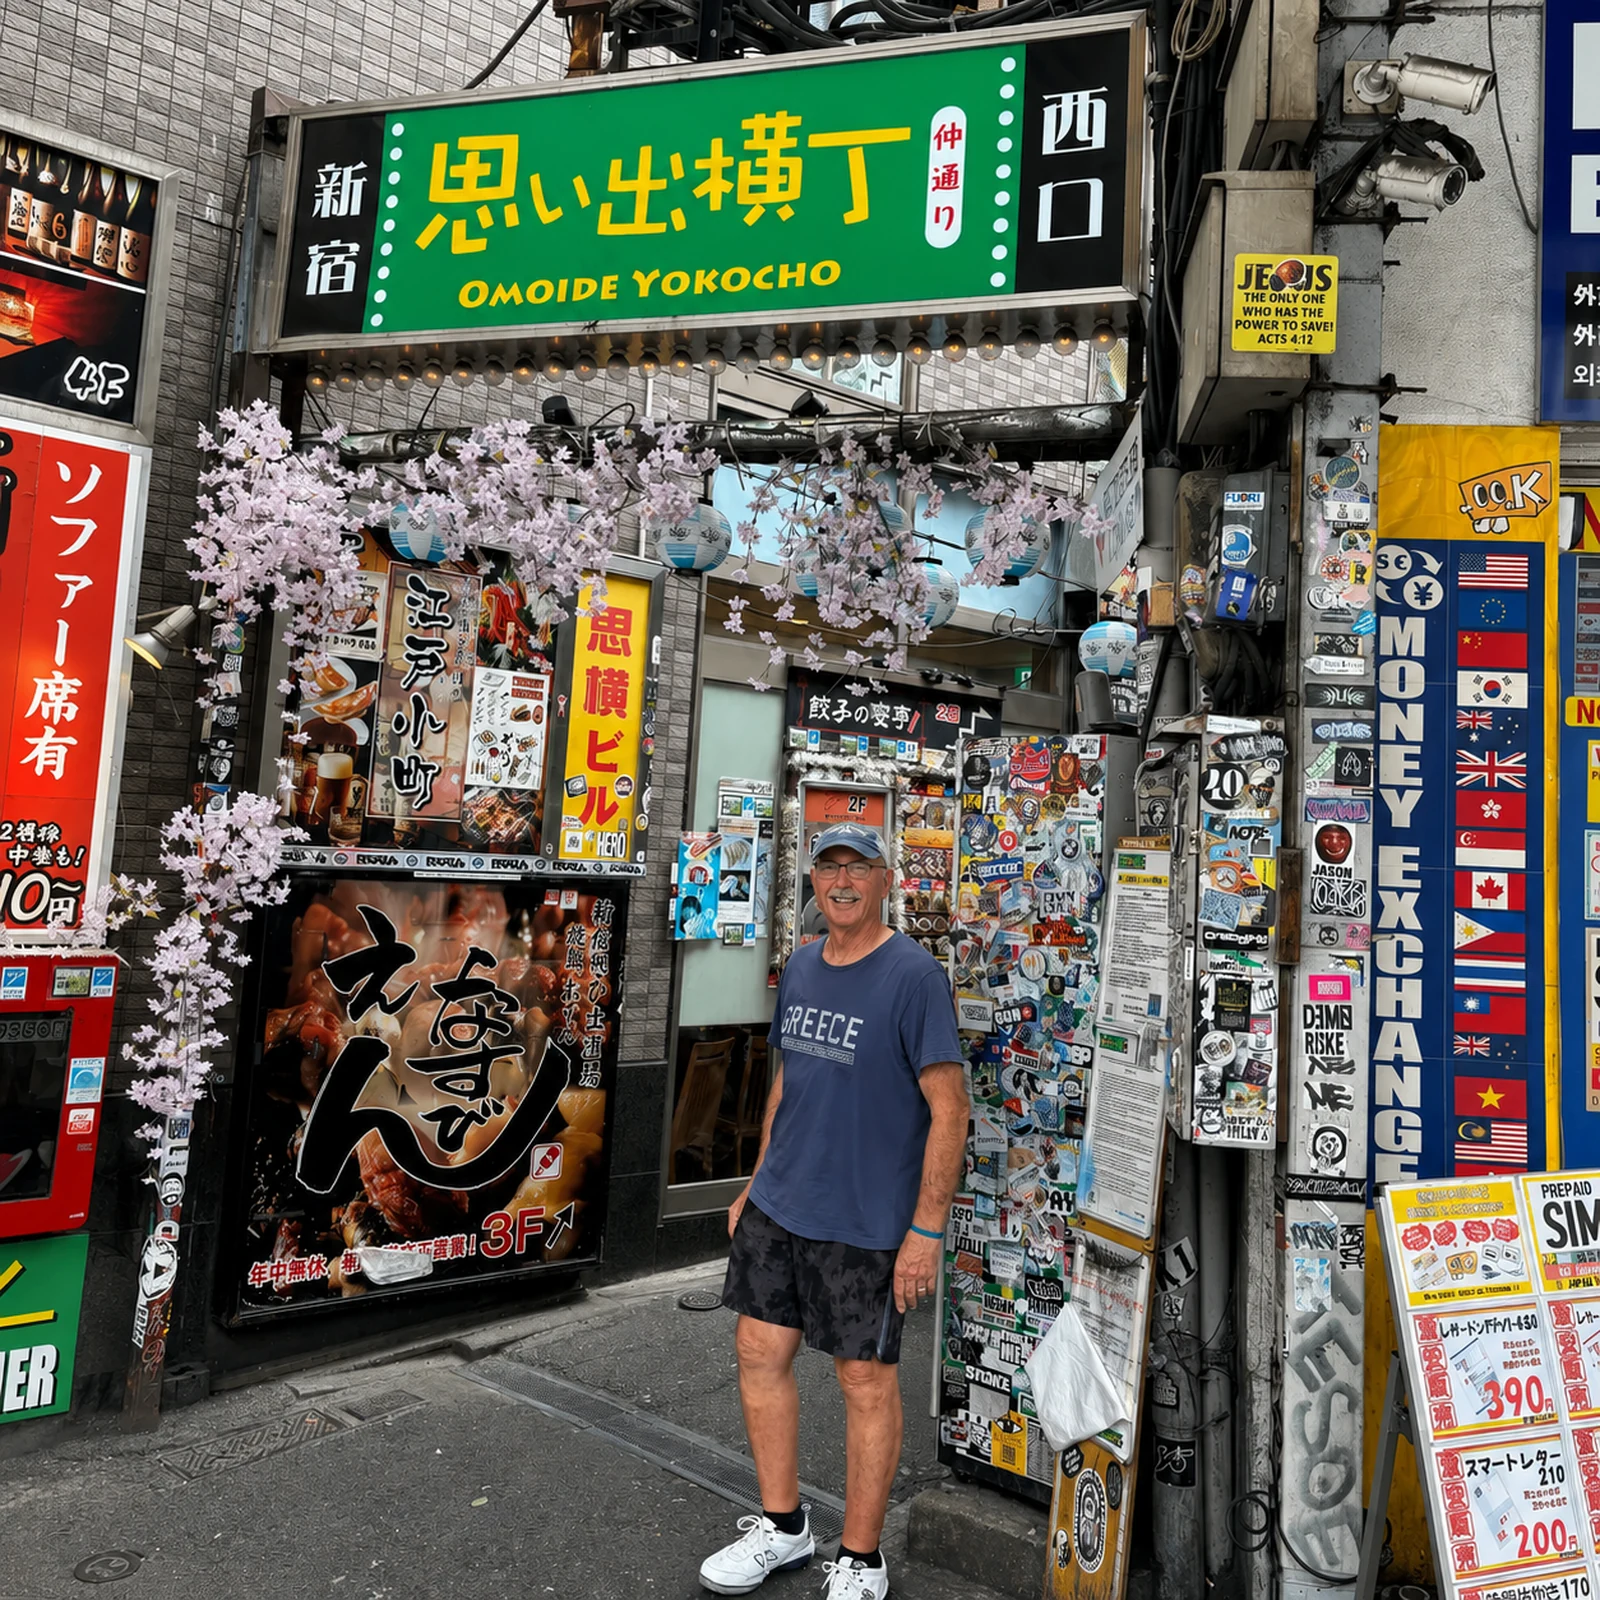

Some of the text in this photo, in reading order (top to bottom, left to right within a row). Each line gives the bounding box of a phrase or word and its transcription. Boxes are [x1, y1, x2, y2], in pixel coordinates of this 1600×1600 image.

[931, 121, 963, 233] 仲通り
[1036, 85, 1109, 243] 西口
[415, 110, 911, 255] 思い出横丁
[305, 160, 368, 296] 新宿
[458, 259, 842, 309] OMOIDE YOKOCHO
[1244, 292, 1326, 304] THE ONLY ONE
[1573, 283, 1600, 307] 外
[1235, 319, 1333, 332] POWER TO SAVE!
[1242, 306, 1324, 318] WHO HAS THE
[1257, 334, 1313, 345] ACTS 4:12
[1573, 324, 1600, 347] 外
[63, 355, 131, 405] 4F
[1572, 362, 1600, 387] 외
[19, 458, 103, 781] ソファー席有
[391, 573, 452, 810] 江戸小町
[578, 606, 634, 827] 思横ビル
[1378, 615, 1427, 828] MONEY
[1577, 700, 1600, 724] N
[848, 795, 868, 815] 2F
[597, 832, 628, 859] HERO
[1312, 863, 1353, 879] JASON
[780, 1005, 865, 1050] GREECE
[1373, 845, 1425, 1181] EXCHANGE
[1540, 1180, 1593, 1199] PREPAID
[480, 1206, 546, 1258] 3F
[1465, 1449, 1561, 1478] スマートレター
[1538, 1465, 1565, 1486] 210
